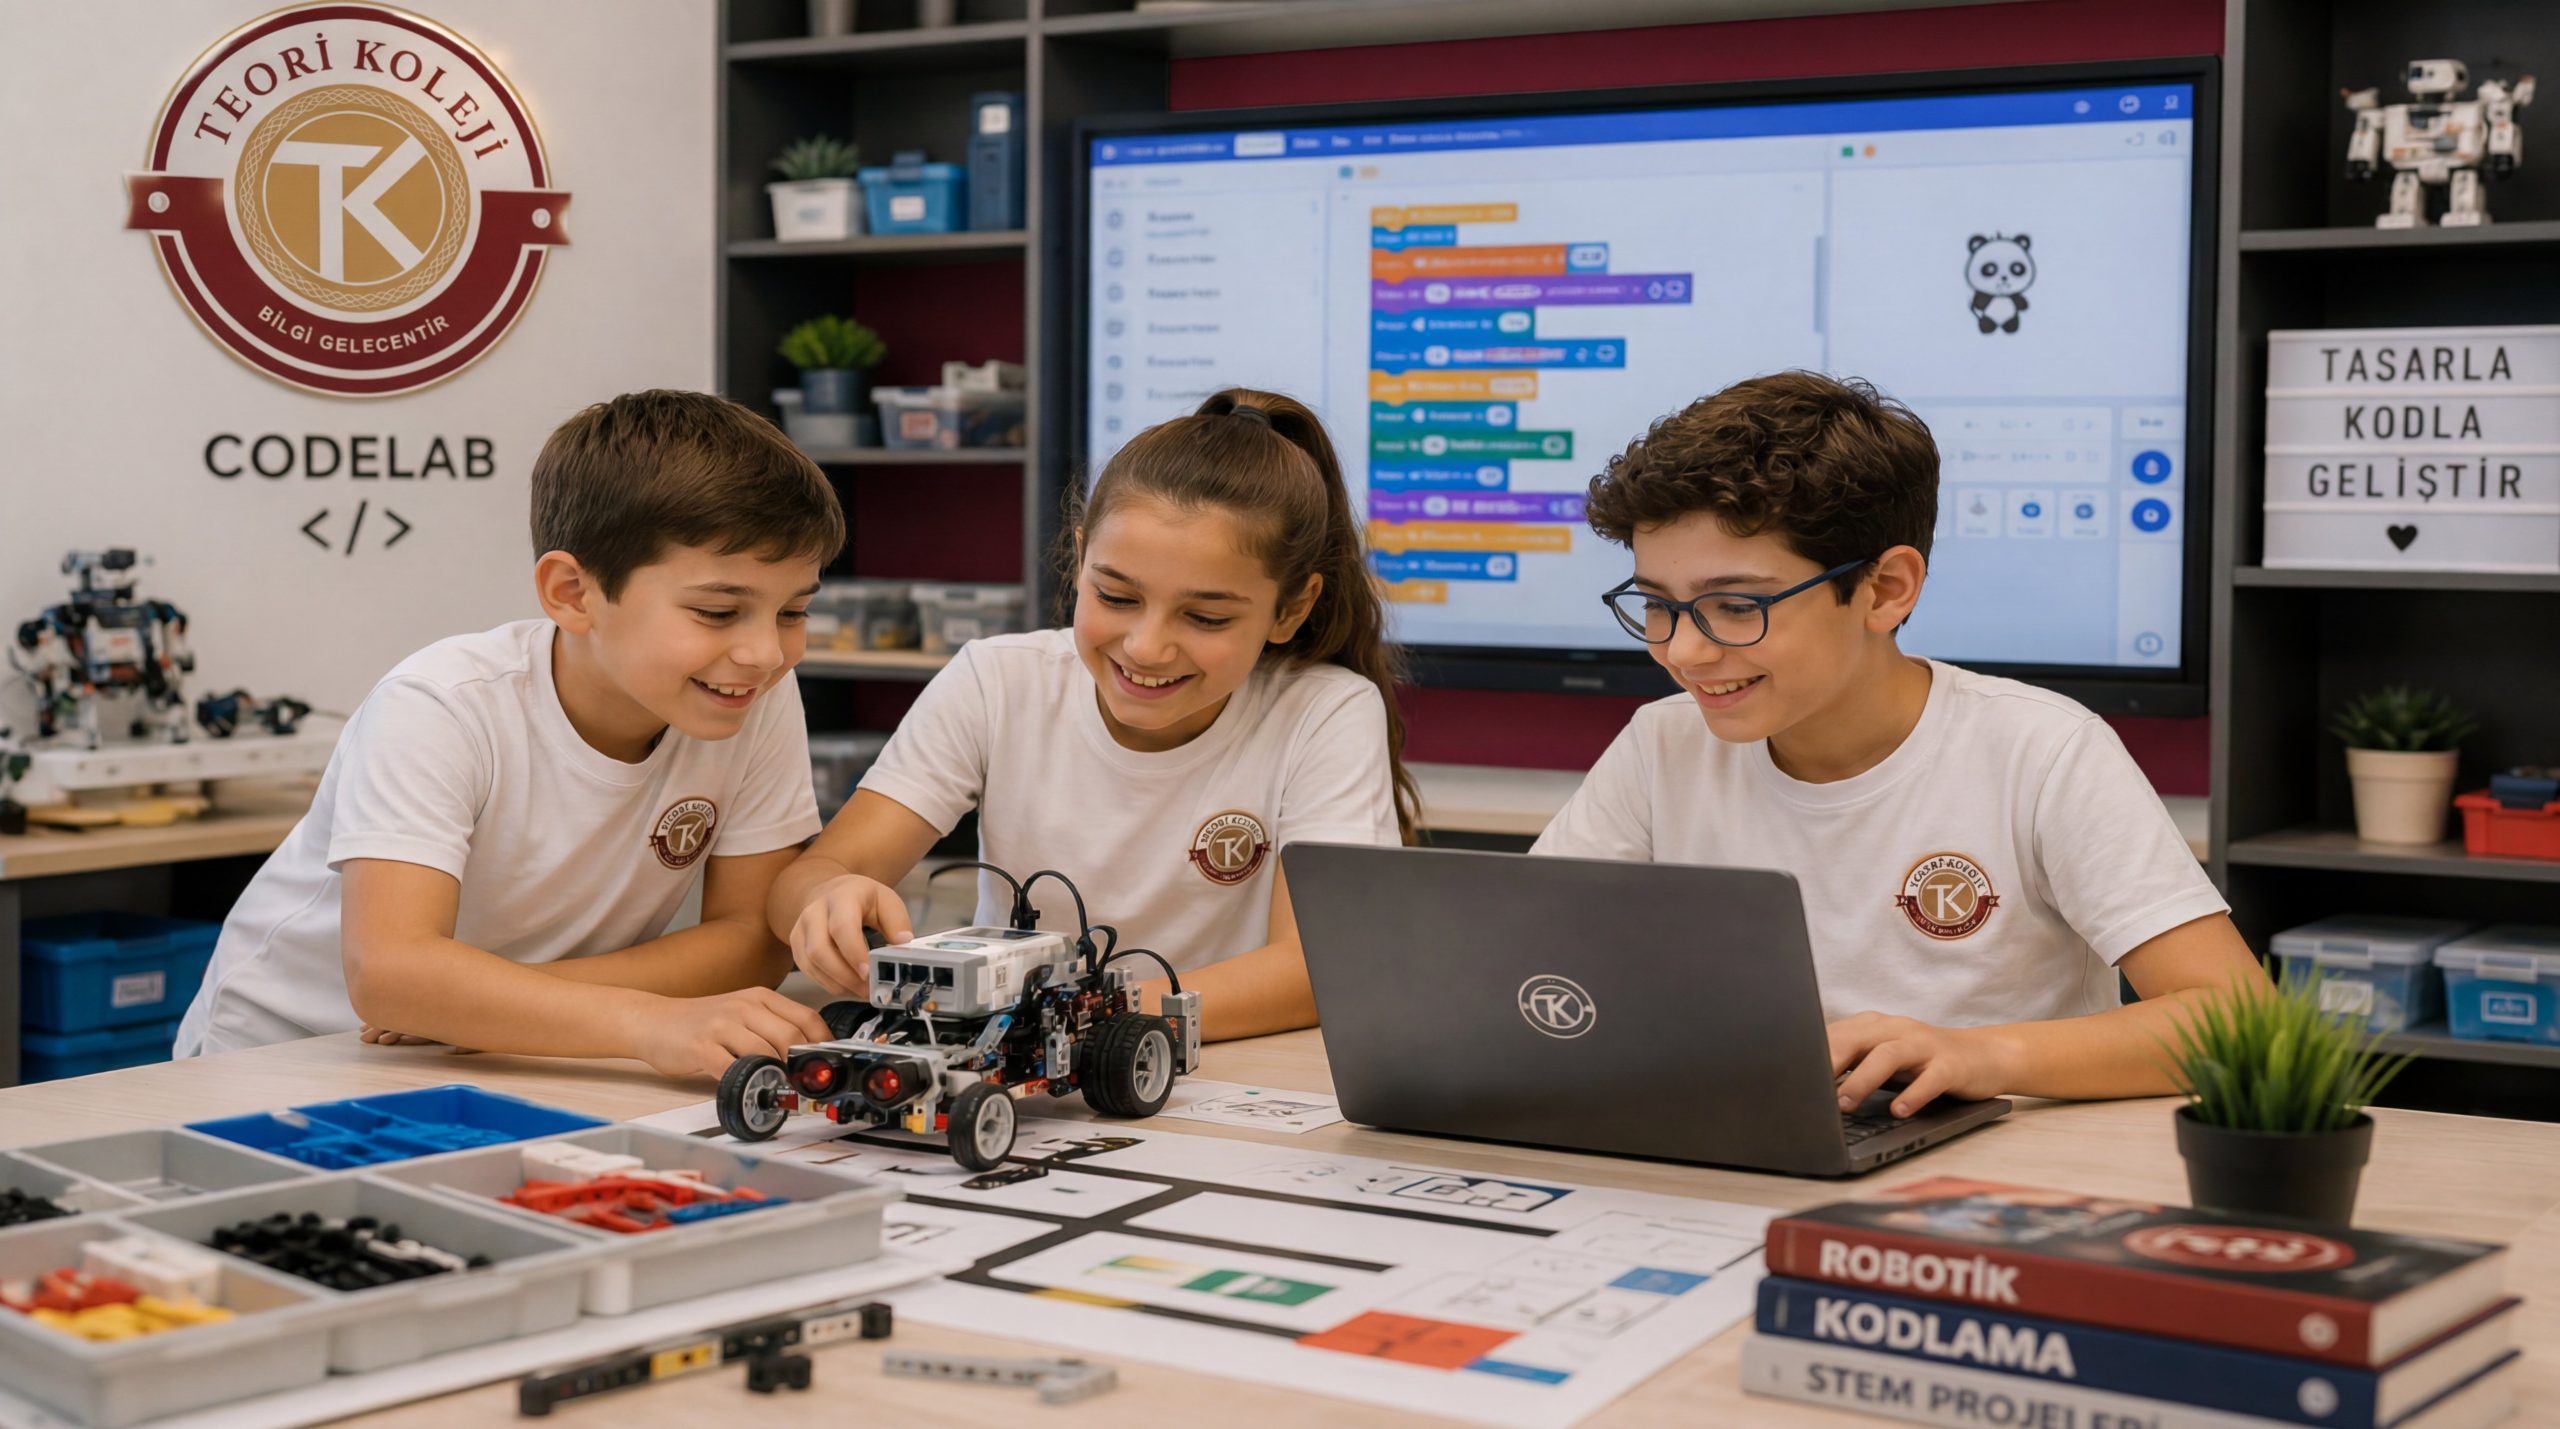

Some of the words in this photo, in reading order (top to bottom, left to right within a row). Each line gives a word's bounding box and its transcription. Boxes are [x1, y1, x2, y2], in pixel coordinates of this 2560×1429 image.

[194, 32, 334, 145] TEORİ
[353, 39, 510, 161] KOLEJİ
[271, 135, 427, 282] TK
[257, 304, 314, 345] BİLGİ
[319, 314, 450, 354] GELECENTİR
[2321, 346, 2512, 382] TASARLA
[2344, 405, 2483, 440] KODLA
[204, 434, 496, 479] CODELAB
[2307, 457, 2522, 502] GELİŞTİR
[1819, 1239, 2020, 1304] ROBOTİK
[1813, 1297, 2077, 1378] KODLAMA
[1806, 1361, 1914, 1405] STEM
